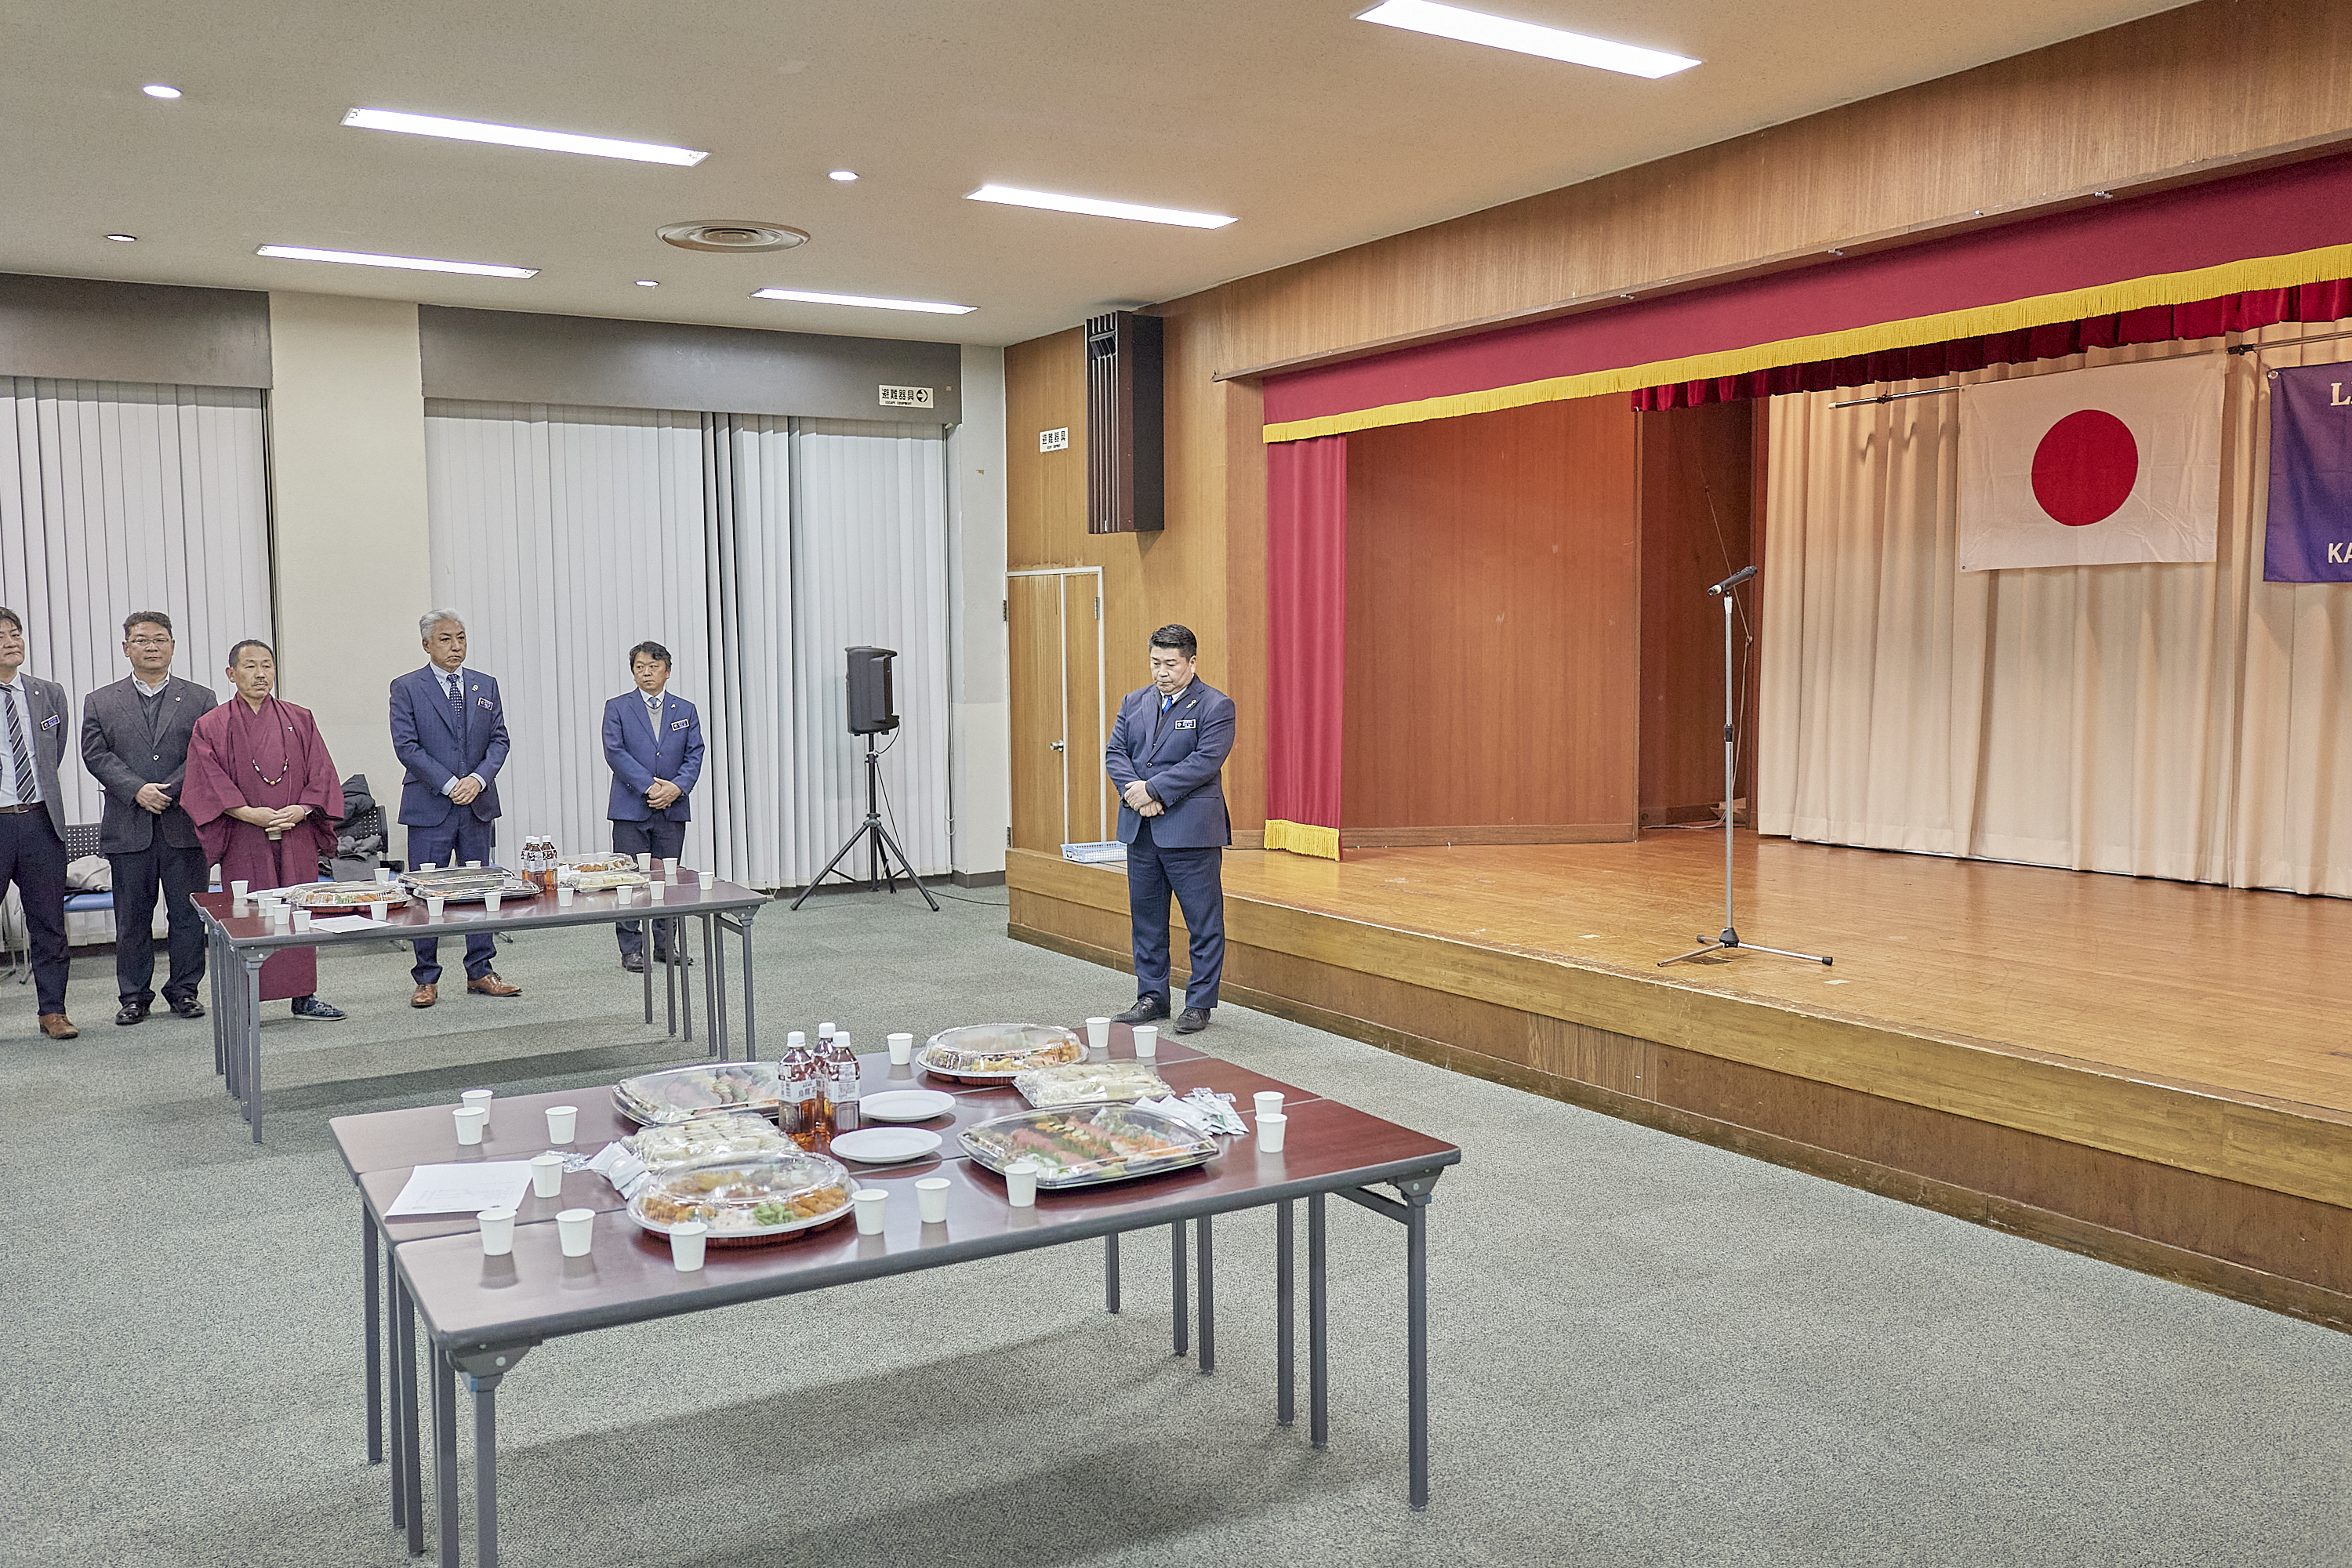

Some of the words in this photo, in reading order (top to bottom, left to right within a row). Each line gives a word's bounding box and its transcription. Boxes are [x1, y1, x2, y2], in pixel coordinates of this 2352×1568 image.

[882, 388, 914, 401] 避難器具
[2330, 382, 2352, 406] L
